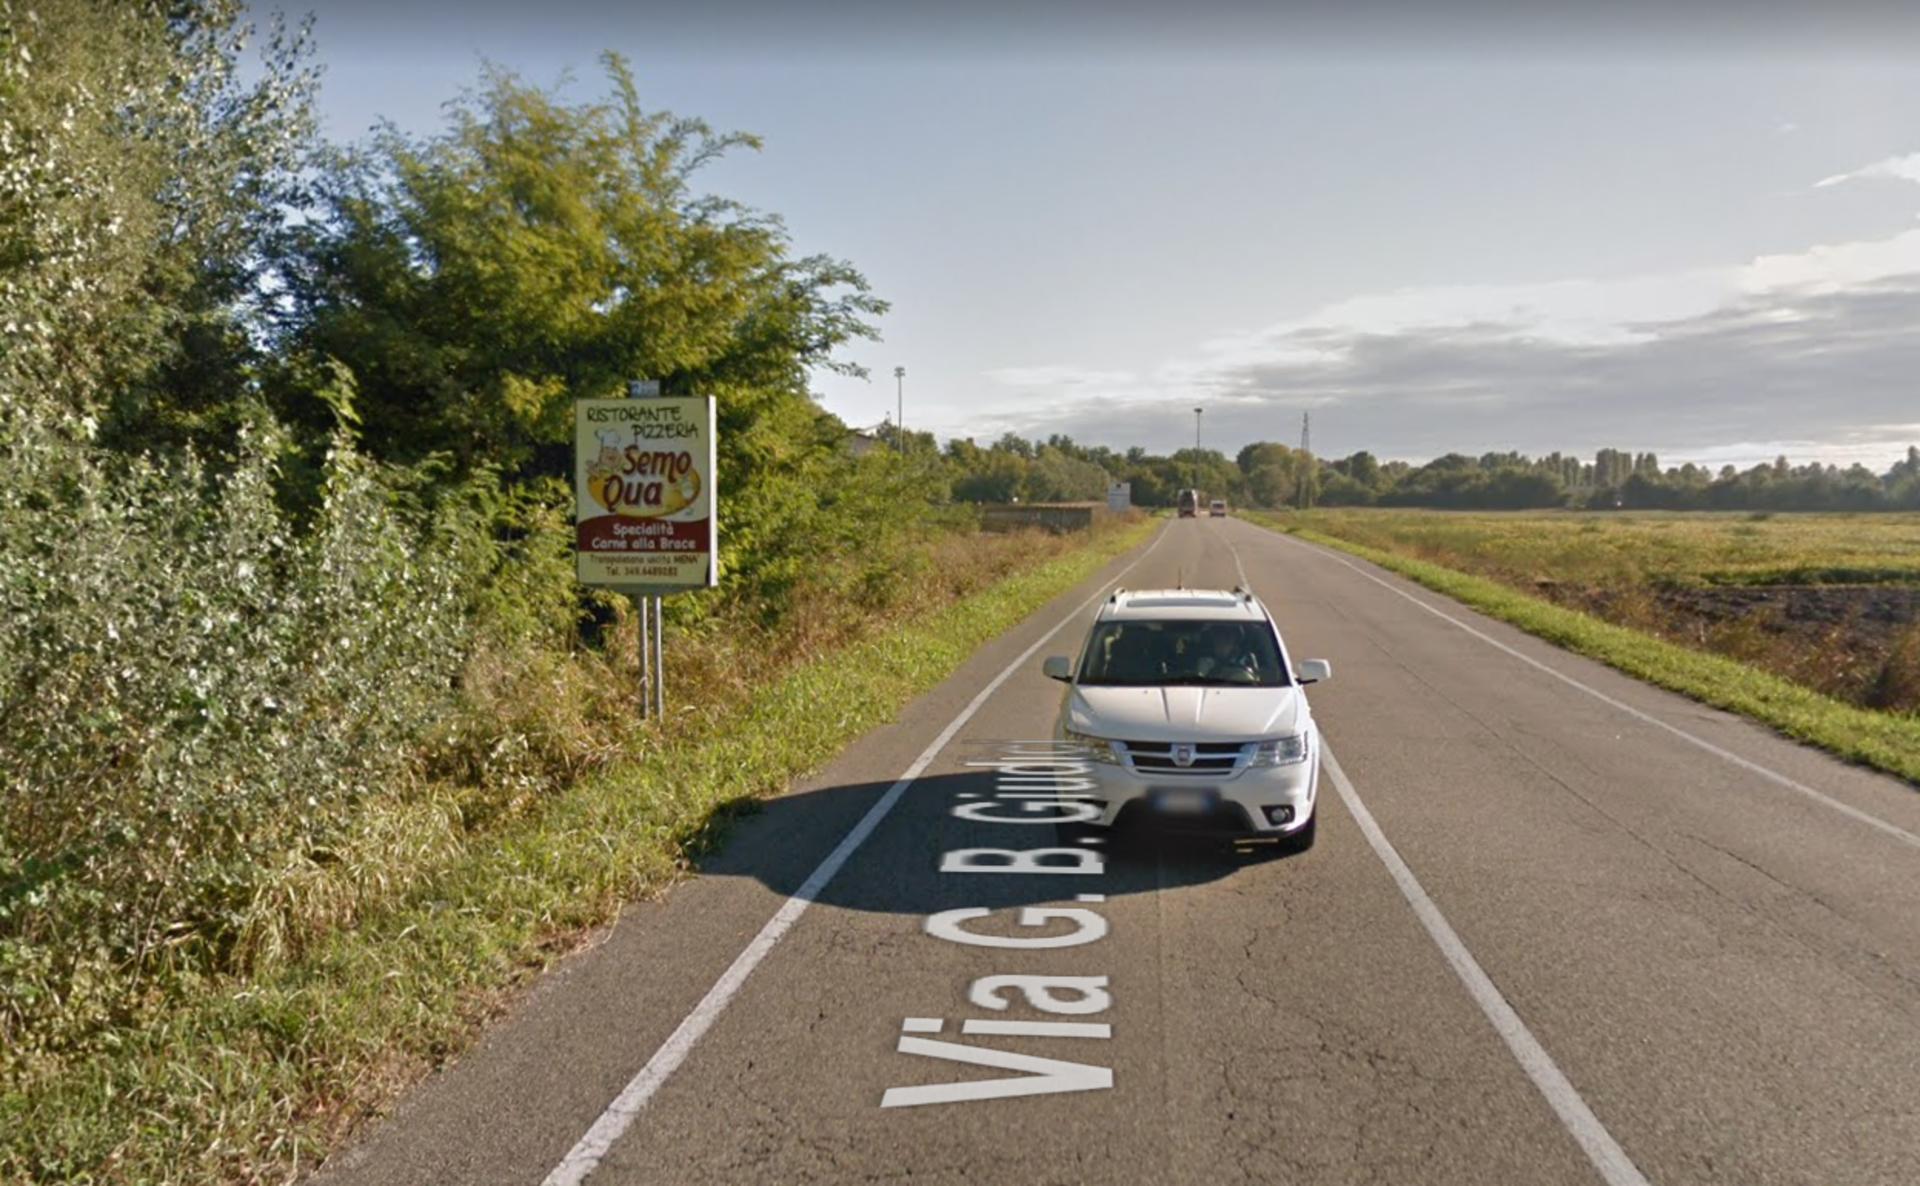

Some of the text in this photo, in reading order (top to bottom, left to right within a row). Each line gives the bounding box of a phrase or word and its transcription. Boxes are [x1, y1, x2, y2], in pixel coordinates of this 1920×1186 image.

[623, 444, 692, 483] Semo
[603, 474, 663, 512] Qua
[613, 521, 675, 538] Specialità
[592, 537, 697, 550] Carne alla Brace
